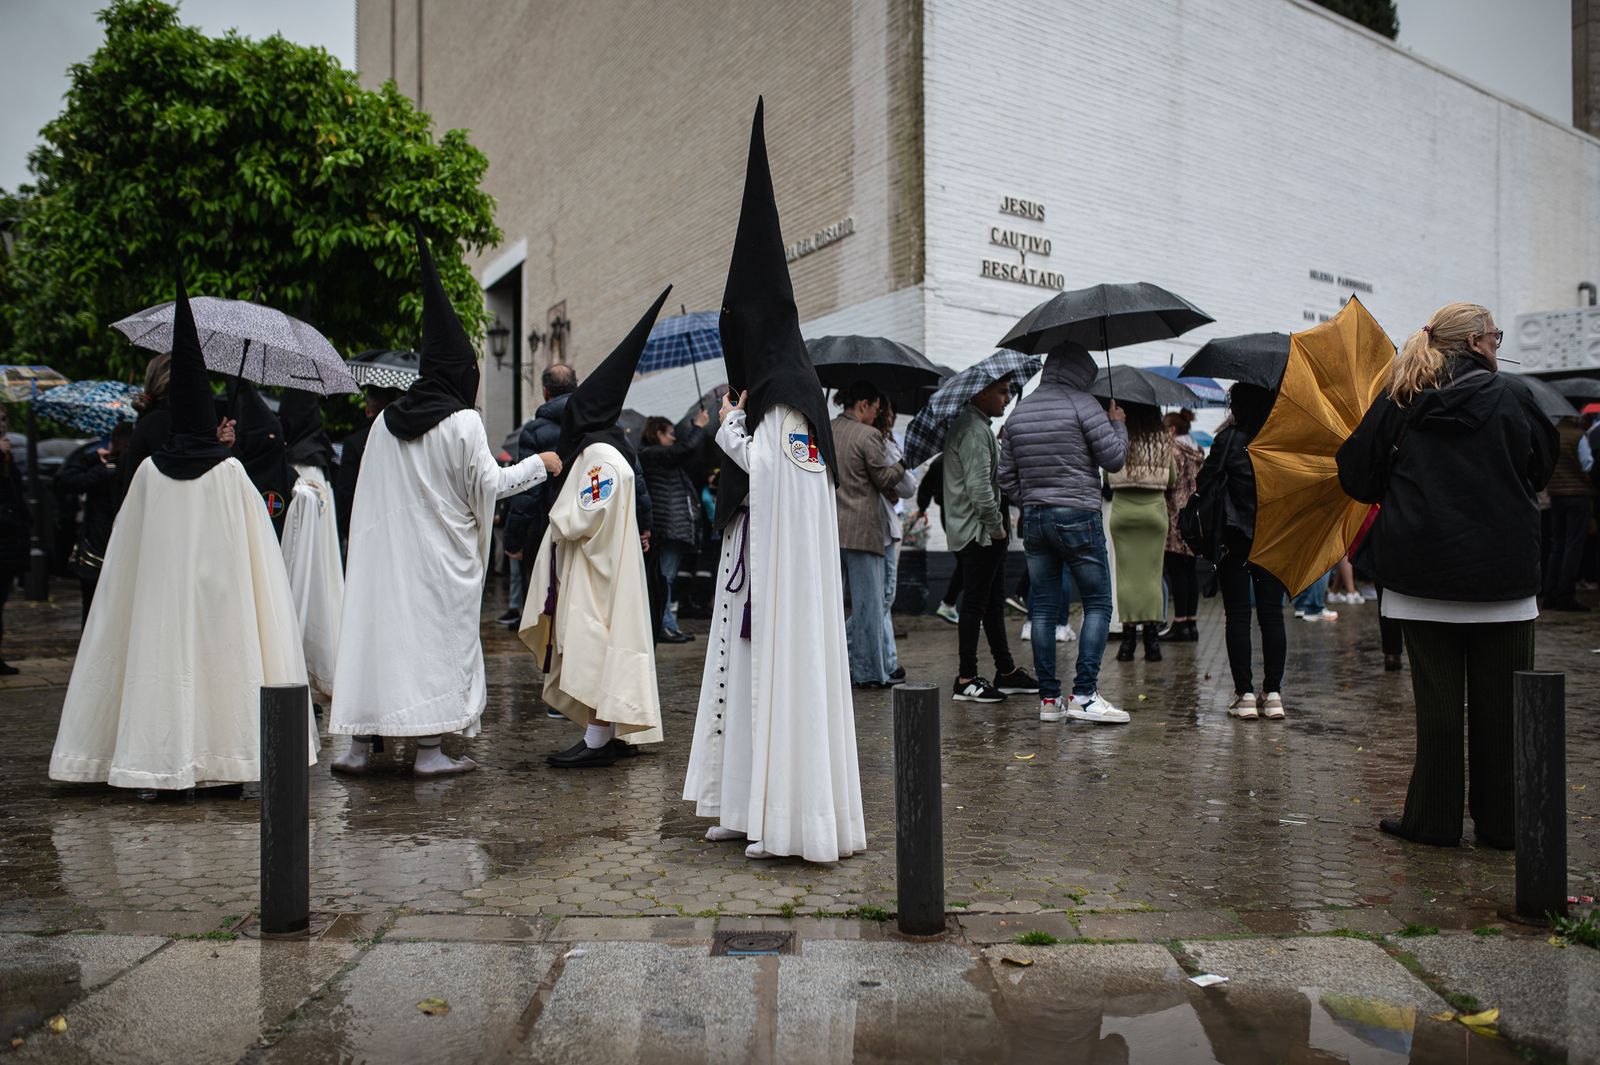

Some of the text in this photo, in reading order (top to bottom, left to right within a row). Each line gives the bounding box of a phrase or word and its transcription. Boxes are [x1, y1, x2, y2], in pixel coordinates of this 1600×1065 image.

[1000, 196, 1046, 220] JESUS
[991, 227, 1052, 254] CAUTIVO
[1020, 249, 1028, 265] Y
[982, 260, 1065, 289] RESCATADO
